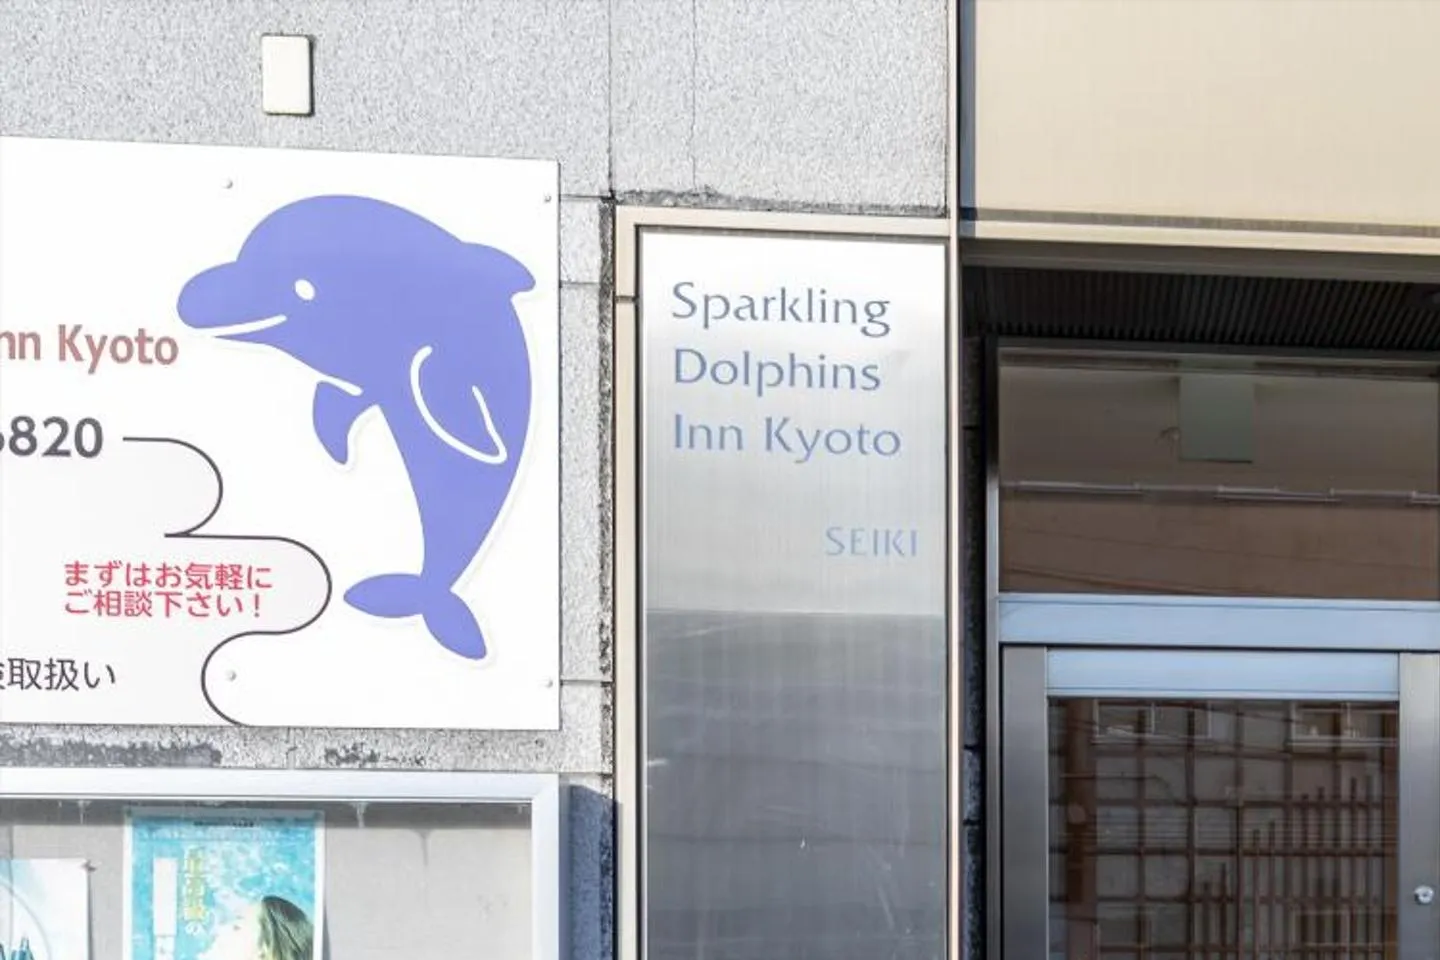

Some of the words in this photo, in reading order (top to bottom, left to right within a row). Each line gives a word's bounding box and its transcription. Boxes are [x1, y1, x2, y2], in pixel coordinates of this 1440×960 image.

[672, 281, 890, 338] Sparkling
[58, 324, 179, 375] Kyoto
[674, 348, 881, 397] Dolphins
[0, 414, 103, 459] 820
[674, 413, 744, 451] Inn
[765, 417, 901, 464] Kyoto
[825, 526, 918, 557] SEIKI
[65, 561, 272, 590] まずはお気軽に
[66, 590, 262, 618] ご相談下さい！
[0, 657, 115, 691] 取扱い
